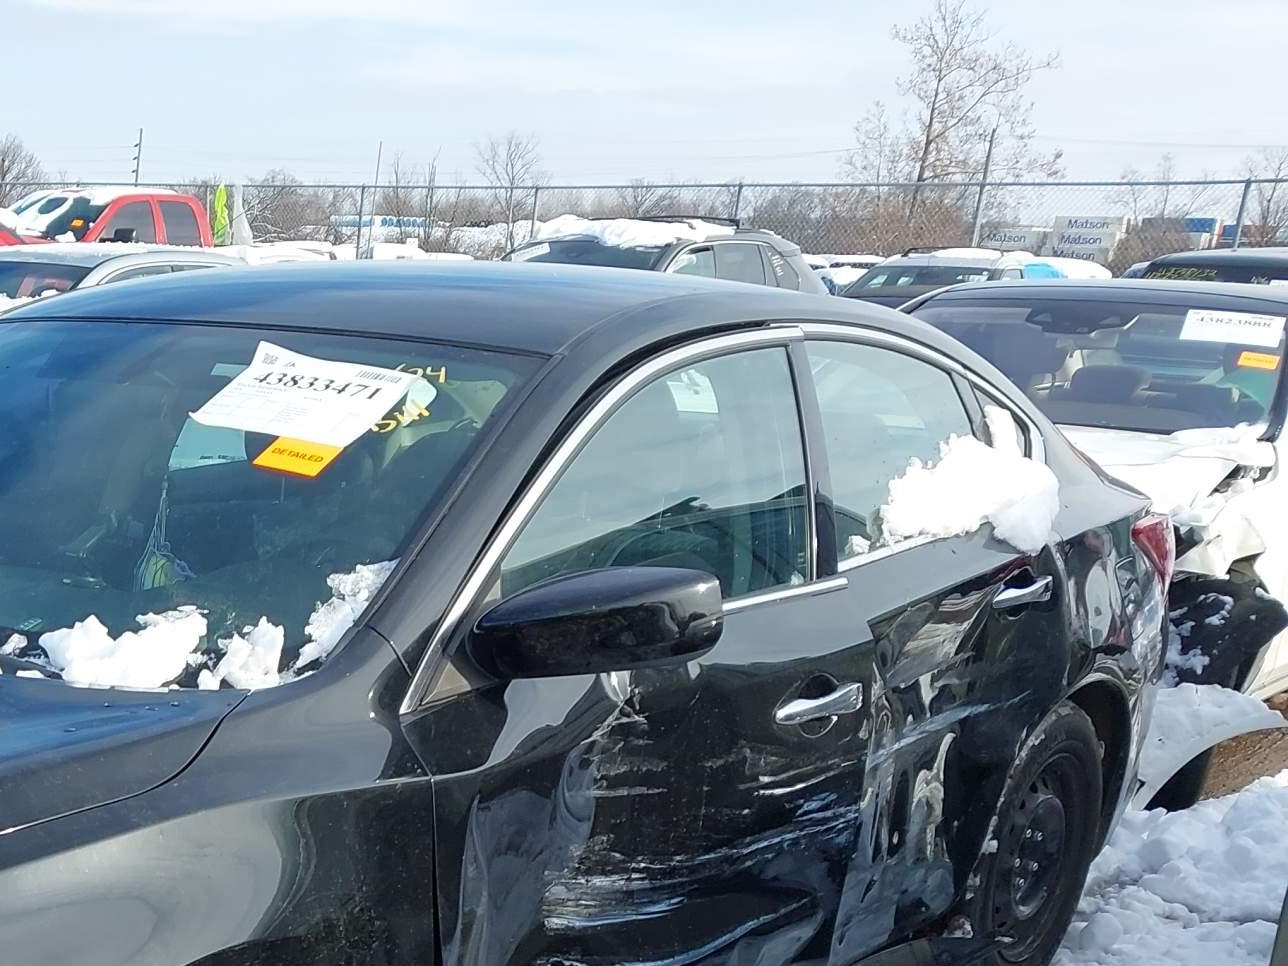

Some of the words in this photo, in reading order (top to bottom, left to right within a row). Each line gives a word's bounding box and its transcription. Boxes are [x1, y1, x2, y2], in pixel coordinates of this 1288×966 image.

[1066, 219, 1110, 230] Matson
[985, 232, 1026, 244] Matson
[1060, 234, 1102, 246] Matson
[252, 369, 384, 401] 43833471
[271, 446, 325, 464] DETAILED
